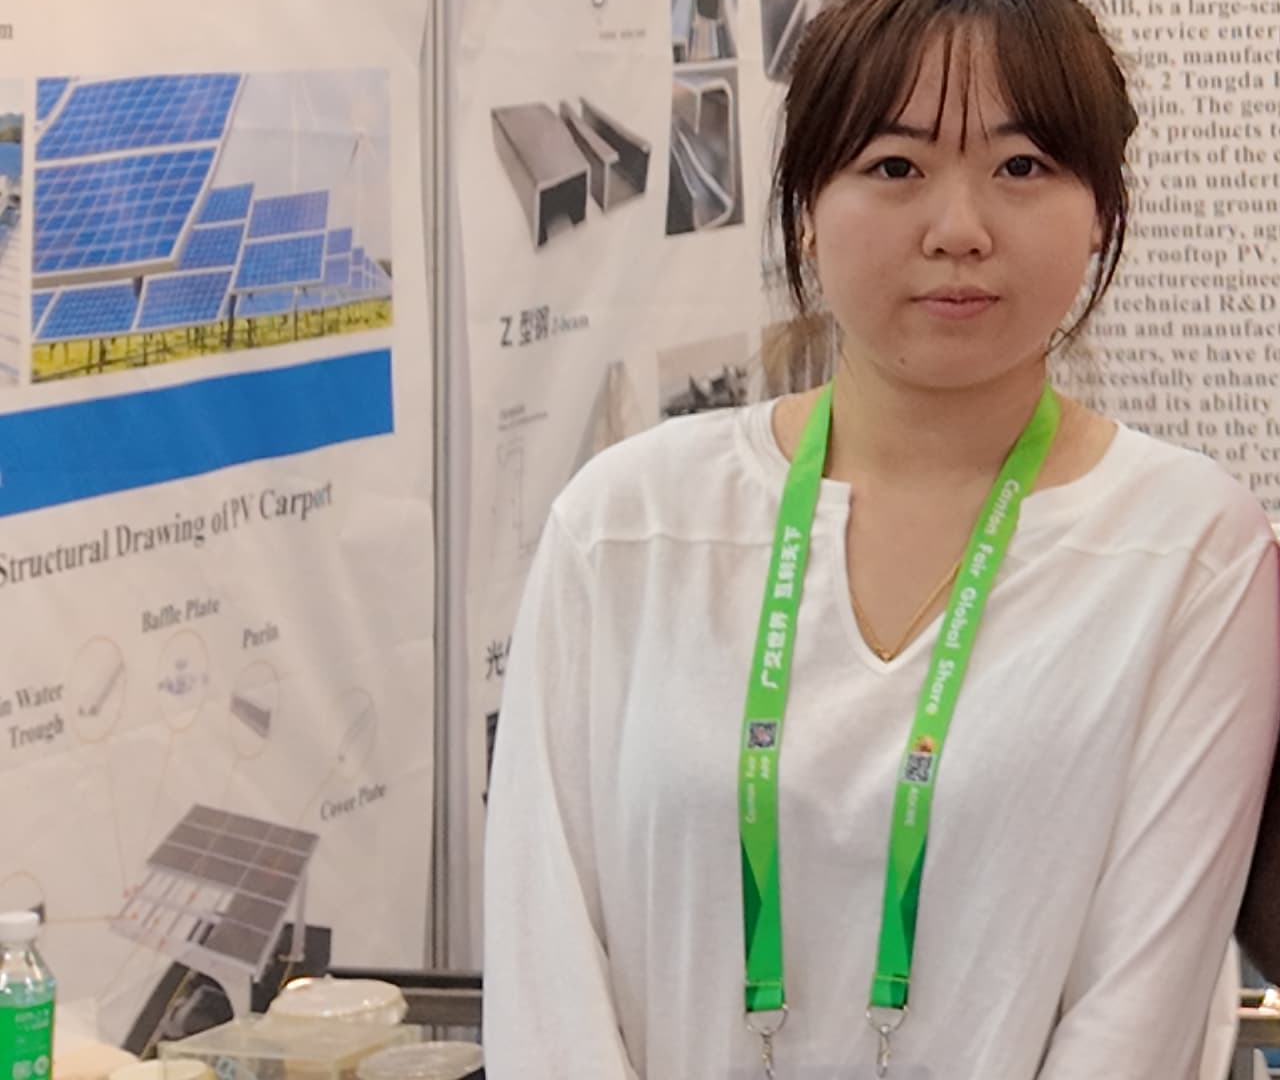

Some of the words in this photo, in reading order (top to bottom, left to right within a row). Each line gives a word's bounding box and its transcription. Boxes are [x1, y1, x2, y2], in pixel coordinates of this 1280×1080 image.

[1131, 21, 1208, 40] service
[1161, 70, 1171, 90] 2
[1184, 69, 1264, 93] Tongda
[1196, 95, 1232, 115] The
[1146, 244, 1227, 268] rooftop
[1237, 243, 1277, 264] PV,
[1113, 293, 1210, 313] technical
[1219, 292, 1276, 313] R&D
[0, 530, 109, 587] Structural
[116, 513, 205, 550] Drawing
[211, 500, 229, 536] of
[970, 542, 994, 577] Fair
[946, 586, 977, 649] Global
[925, 659, 955, 716] Share
